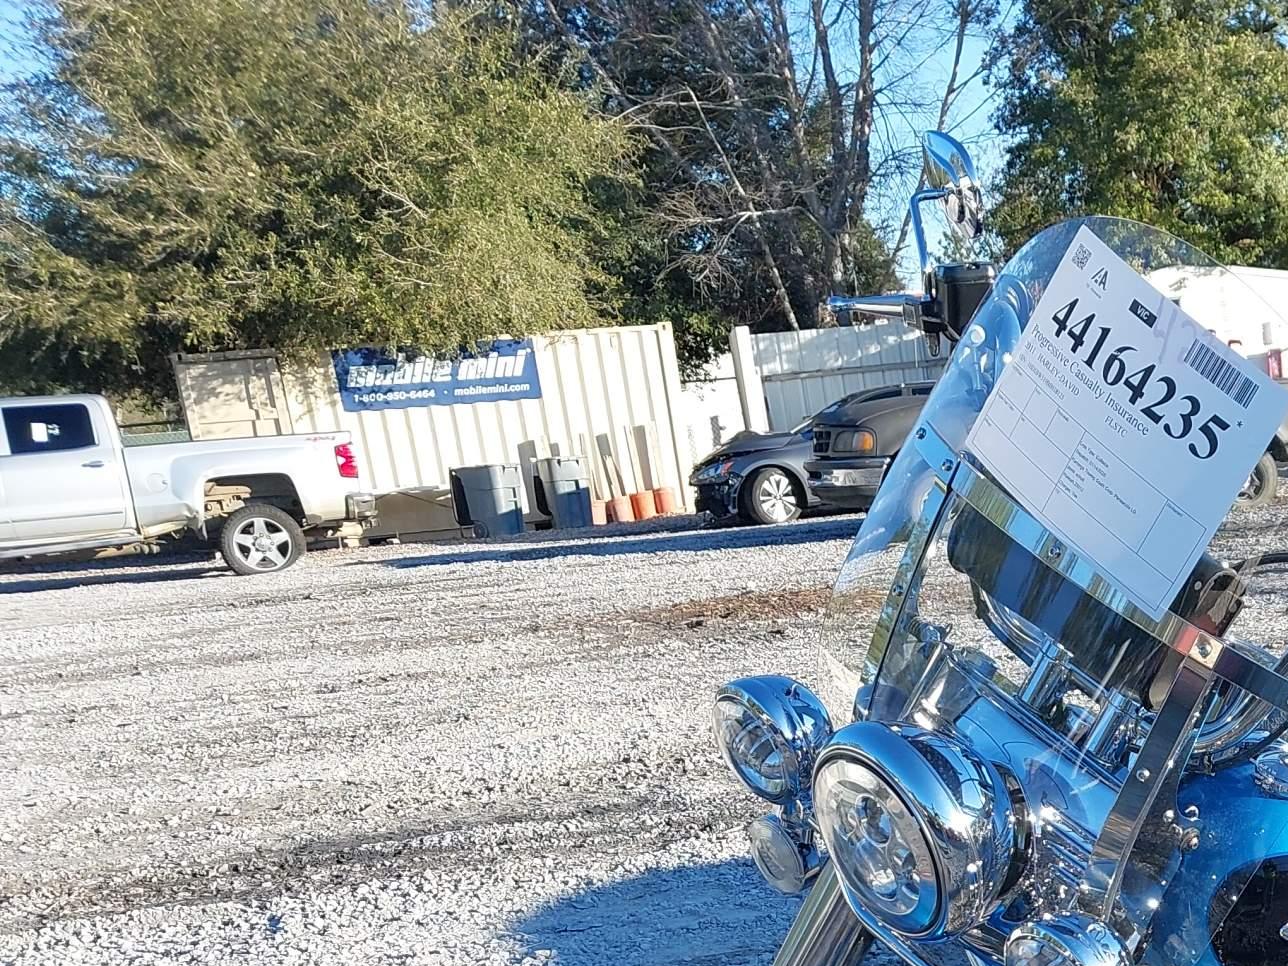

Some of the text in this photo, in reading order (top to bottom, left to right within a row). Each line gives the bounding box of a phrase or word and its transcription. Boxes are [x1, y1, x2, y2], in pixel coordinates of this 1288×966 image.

[1136, 304, 1150, 321] VIC
[353, 383, 530, 403] 1-800-950-6464 mobilemini.com
[457, 347, 532, 381] mini
[1031, 323, 1070, 367] Progressive
[1069, 361, 1105, 400] Casualty
[1104, 392, 1150, 436] Insurance
[1051, 297, 1231, 460] 44164235
[1037, 353, 1081, 397] HARLEY-DAVID
[1104, 415, 1128, 438] FLSTC
